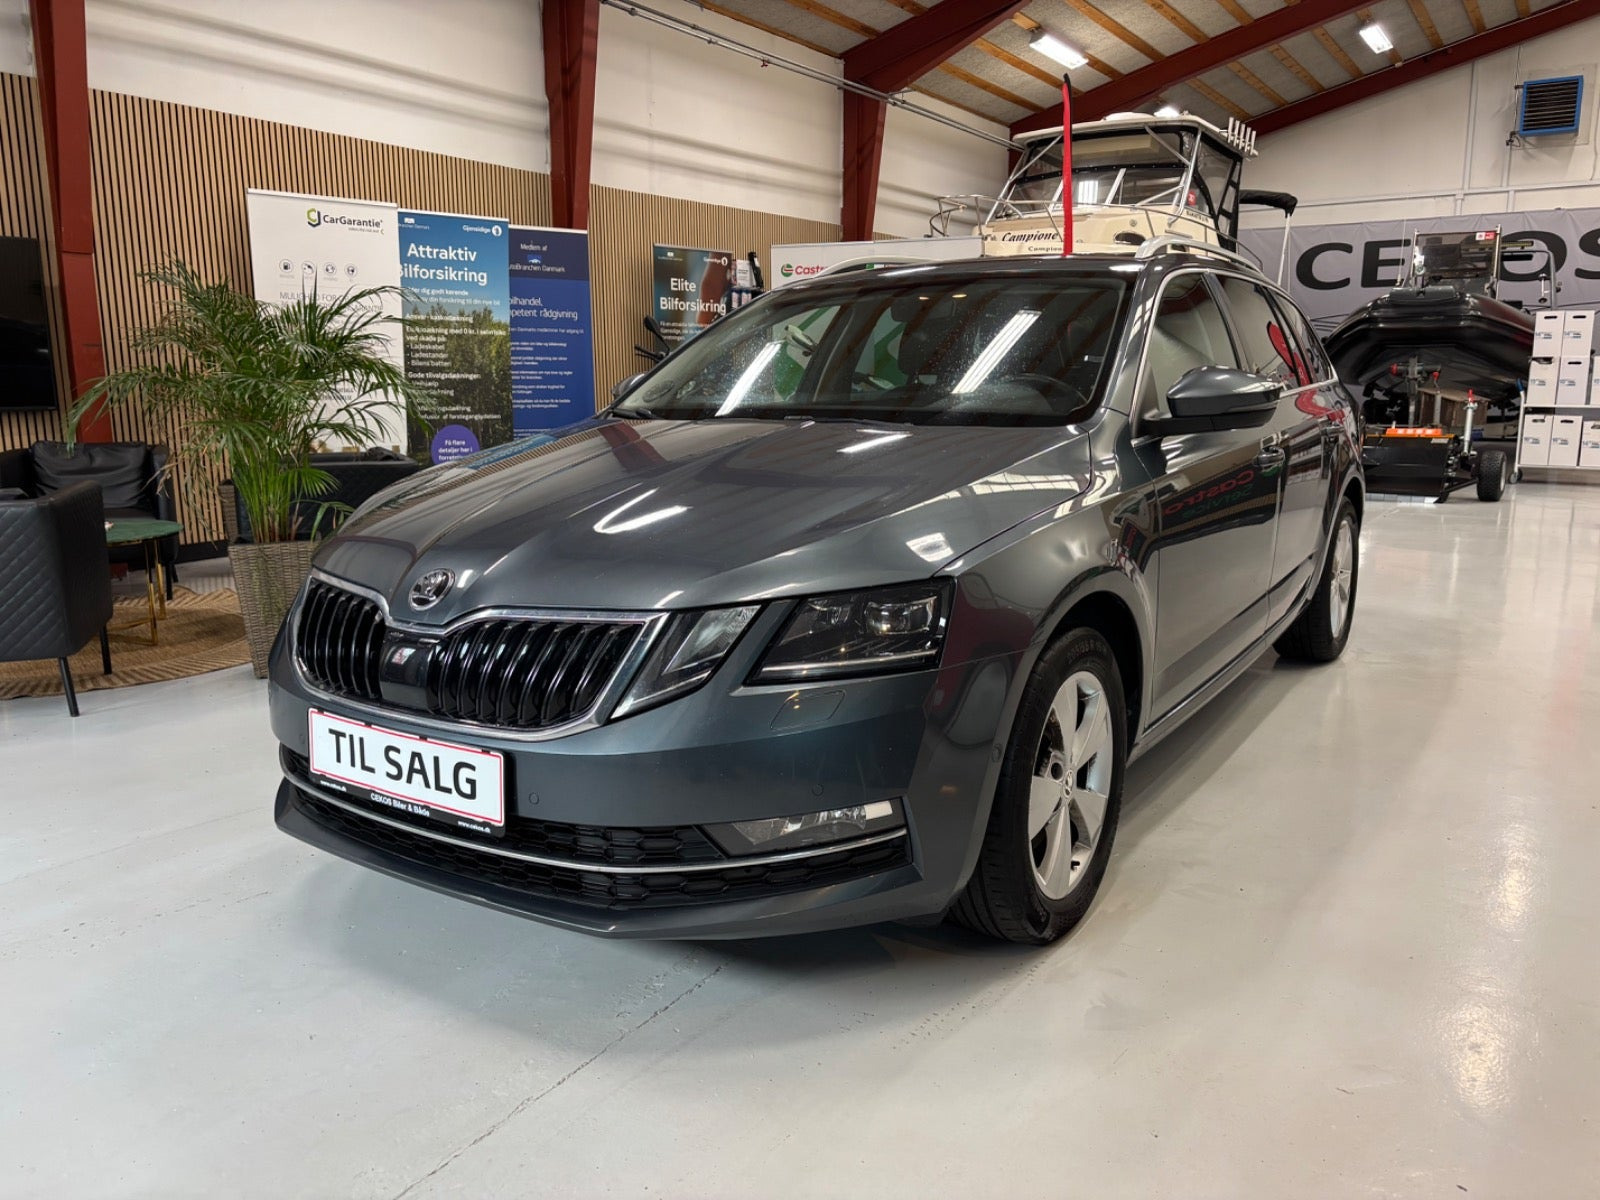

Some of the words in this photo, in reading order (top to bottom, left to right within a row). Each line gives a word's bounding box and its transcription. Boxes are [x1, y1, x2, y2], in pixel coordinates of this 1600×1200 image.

[323, 214, 381, 228] CarGarantie
[462, 225, 491, 234] Gjensidige
[1002, 230, 1060, 242] Campione
[407, 243, 477, 262] Attraktiv
[520, 243, 541, 251] Medlem
[541, 264, 566, 272] Danmark
[670, 278, 697, 292] Elite
[322, 293, 337, 301] FOR
[660, 296, 727, 316] Bilforsikring
[510, 308, 537, 318] petent
[540, 308, 578, 321] rådgivning
[408, 371, 425, 379] Gode
[328, 728, 376, 774] TIL
[384, 745, 477, 800] SALG
[370, 793, 392, 807] CEKOS
[393, 799, 407, 810] Biler
[407, 803, 413, 812] &
[414, 805, 430, 817] Både
